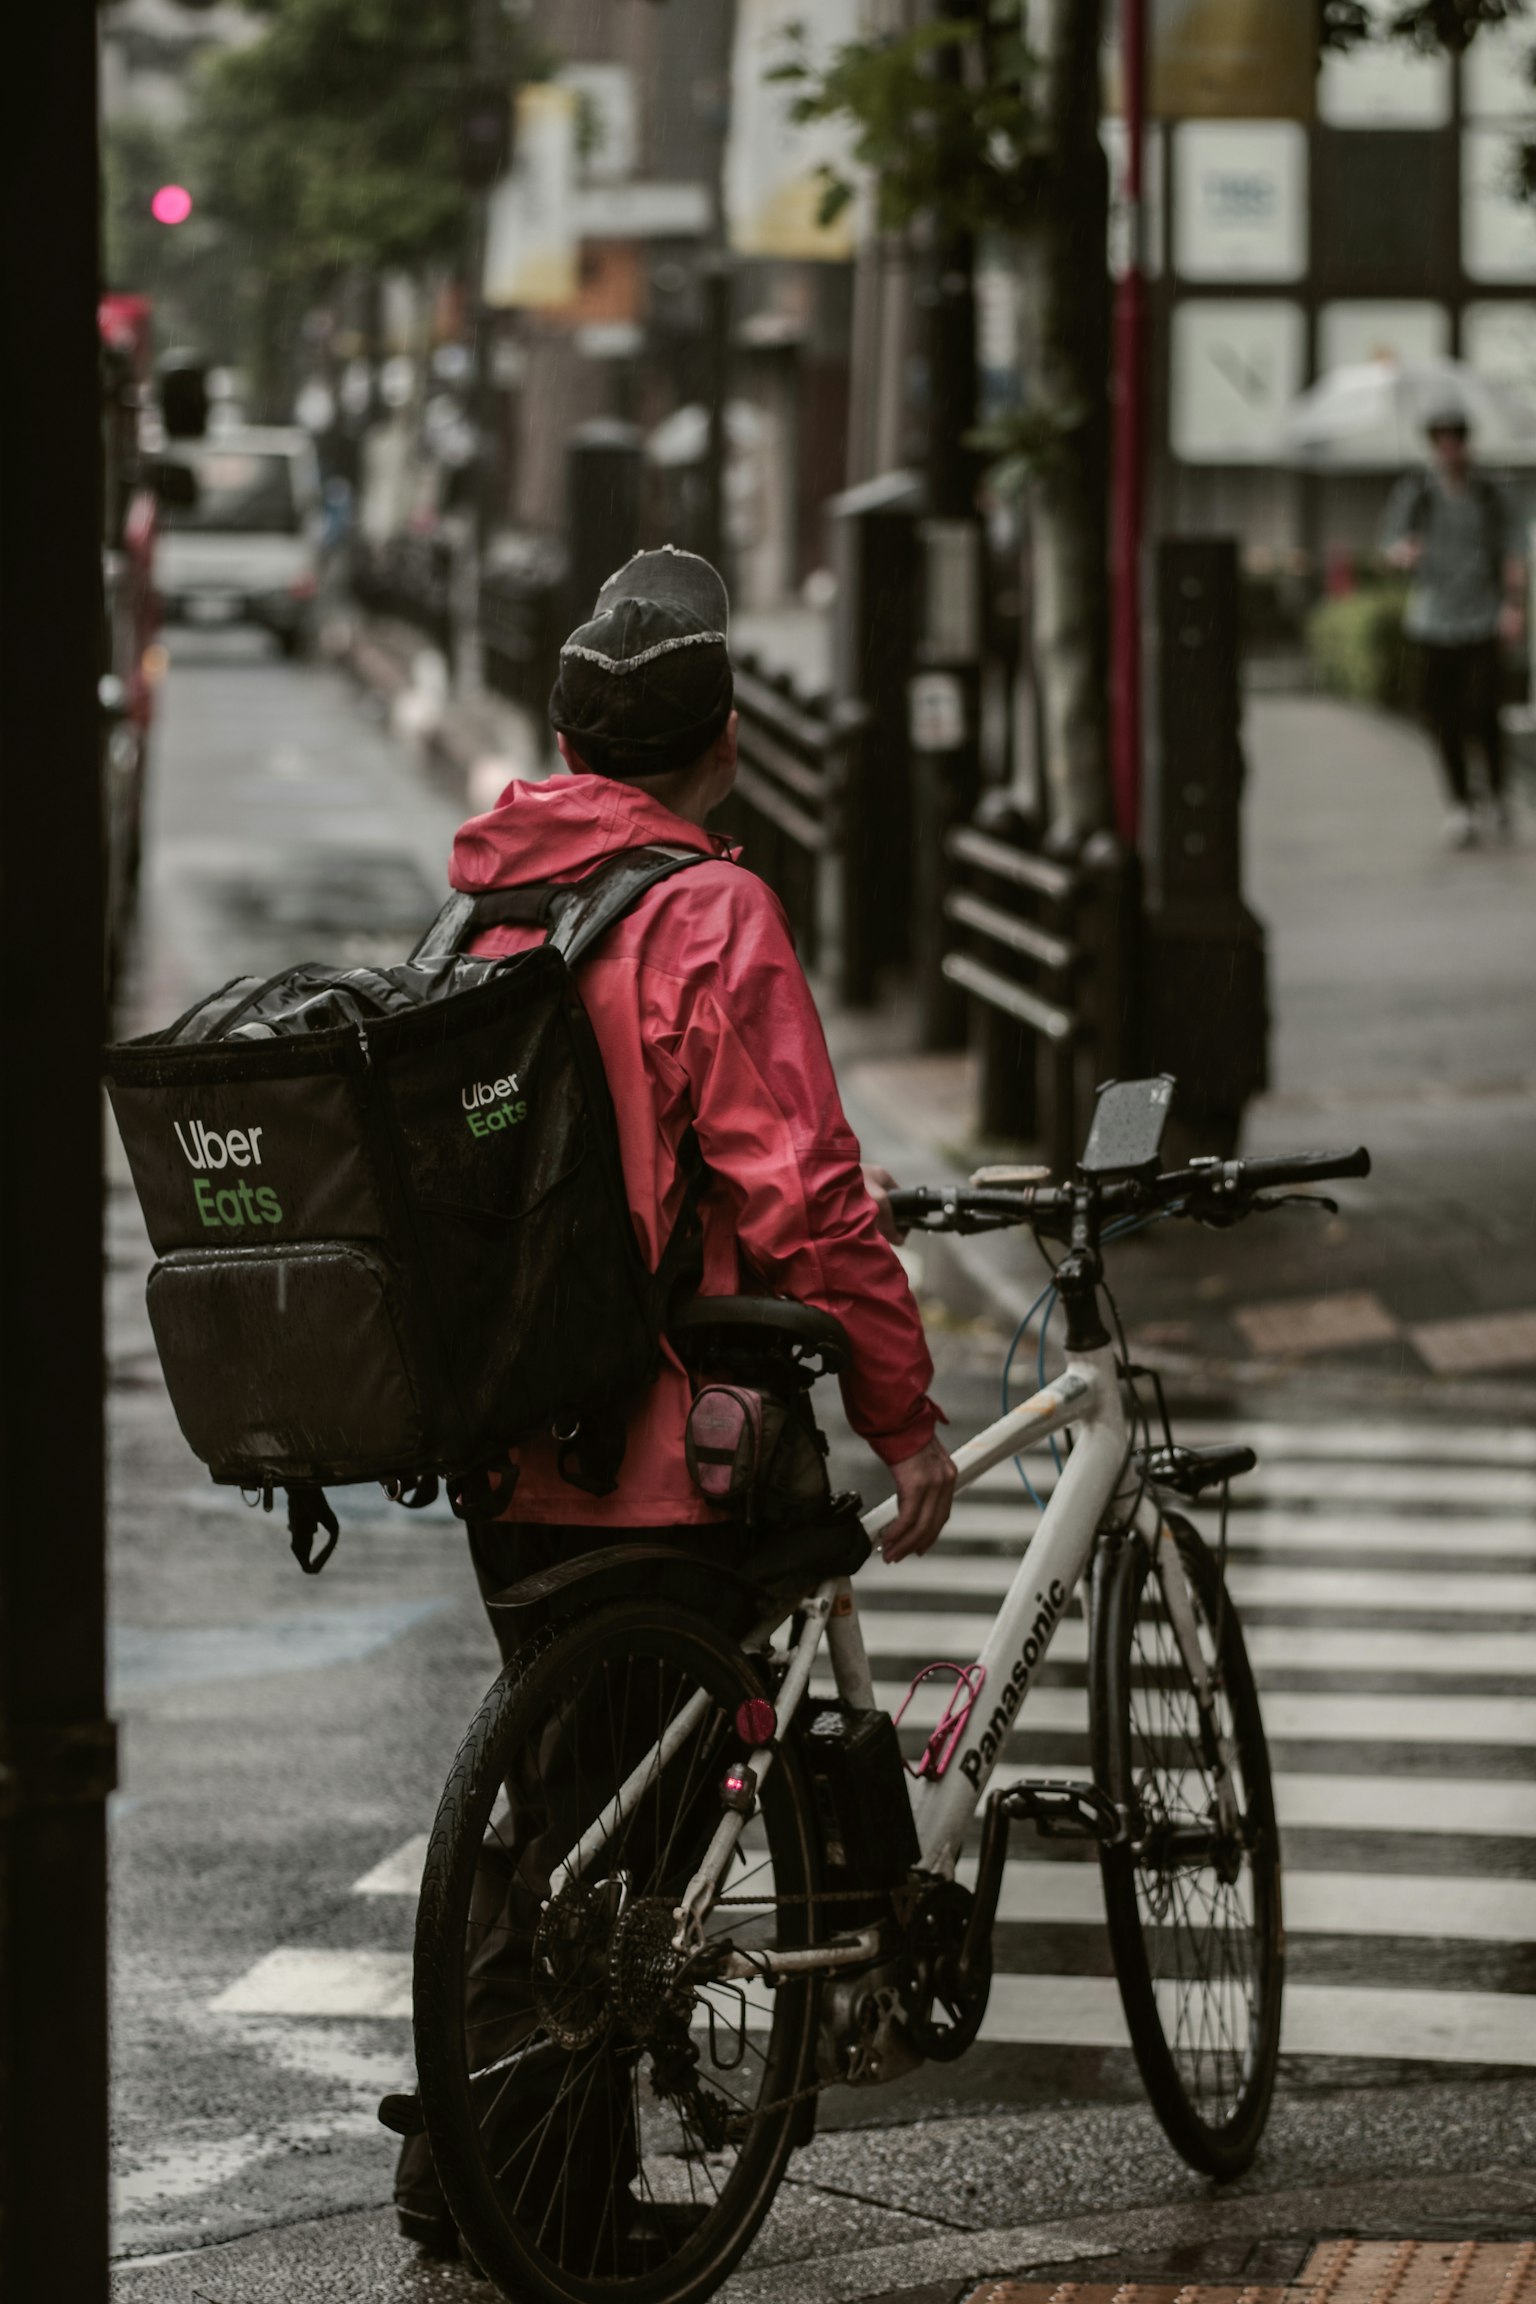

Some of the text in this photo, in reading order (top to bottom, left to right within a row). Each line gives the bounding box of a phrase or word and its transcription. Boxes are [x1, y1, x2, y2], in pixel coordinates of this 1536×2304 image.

[461, 1072, 520, 1110] Uber
[466, 1100, 528, 1139] Eats
[174, 1120, 263, 1169] Uber
[193, 1178, 283, 1227] Eats
[960, 1579, 1065, 1791] Panasonic
